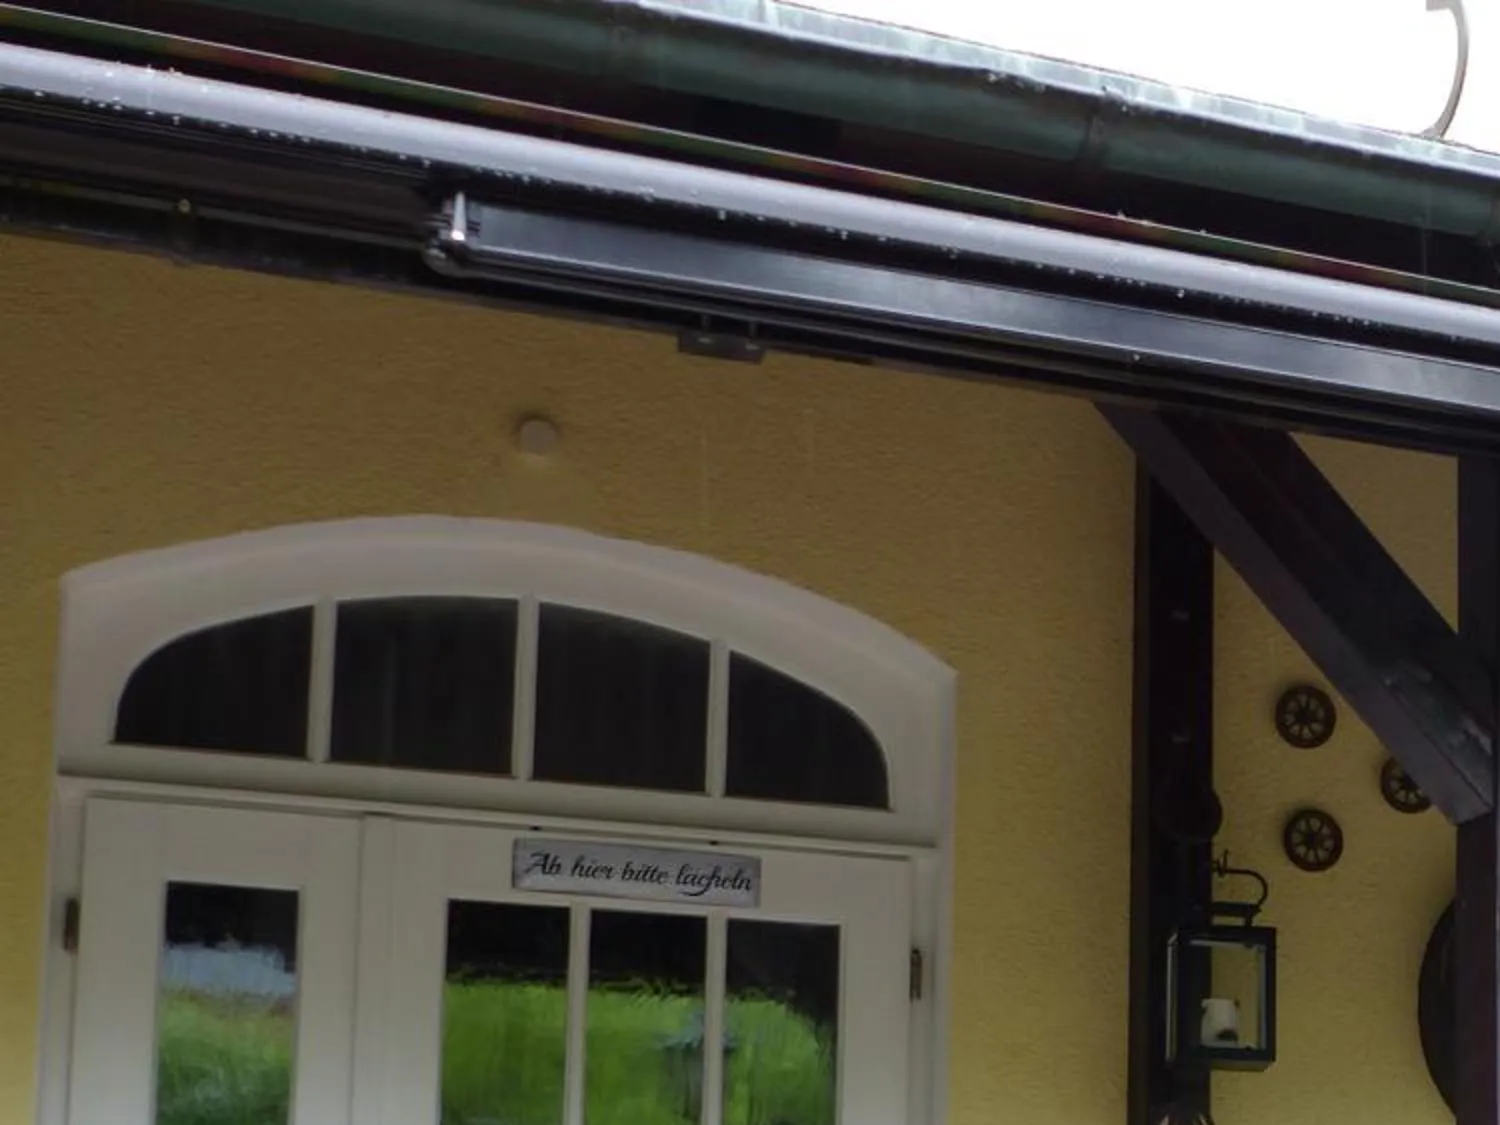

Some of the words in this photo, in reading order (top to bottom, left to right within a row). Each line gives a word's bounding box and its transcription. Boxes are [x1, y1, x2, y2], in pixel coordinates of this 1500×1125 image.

[523, 850, 562, 876] Ab
[570, 854, 614, 880] hier
[621, 861, 669, 885] bitte
